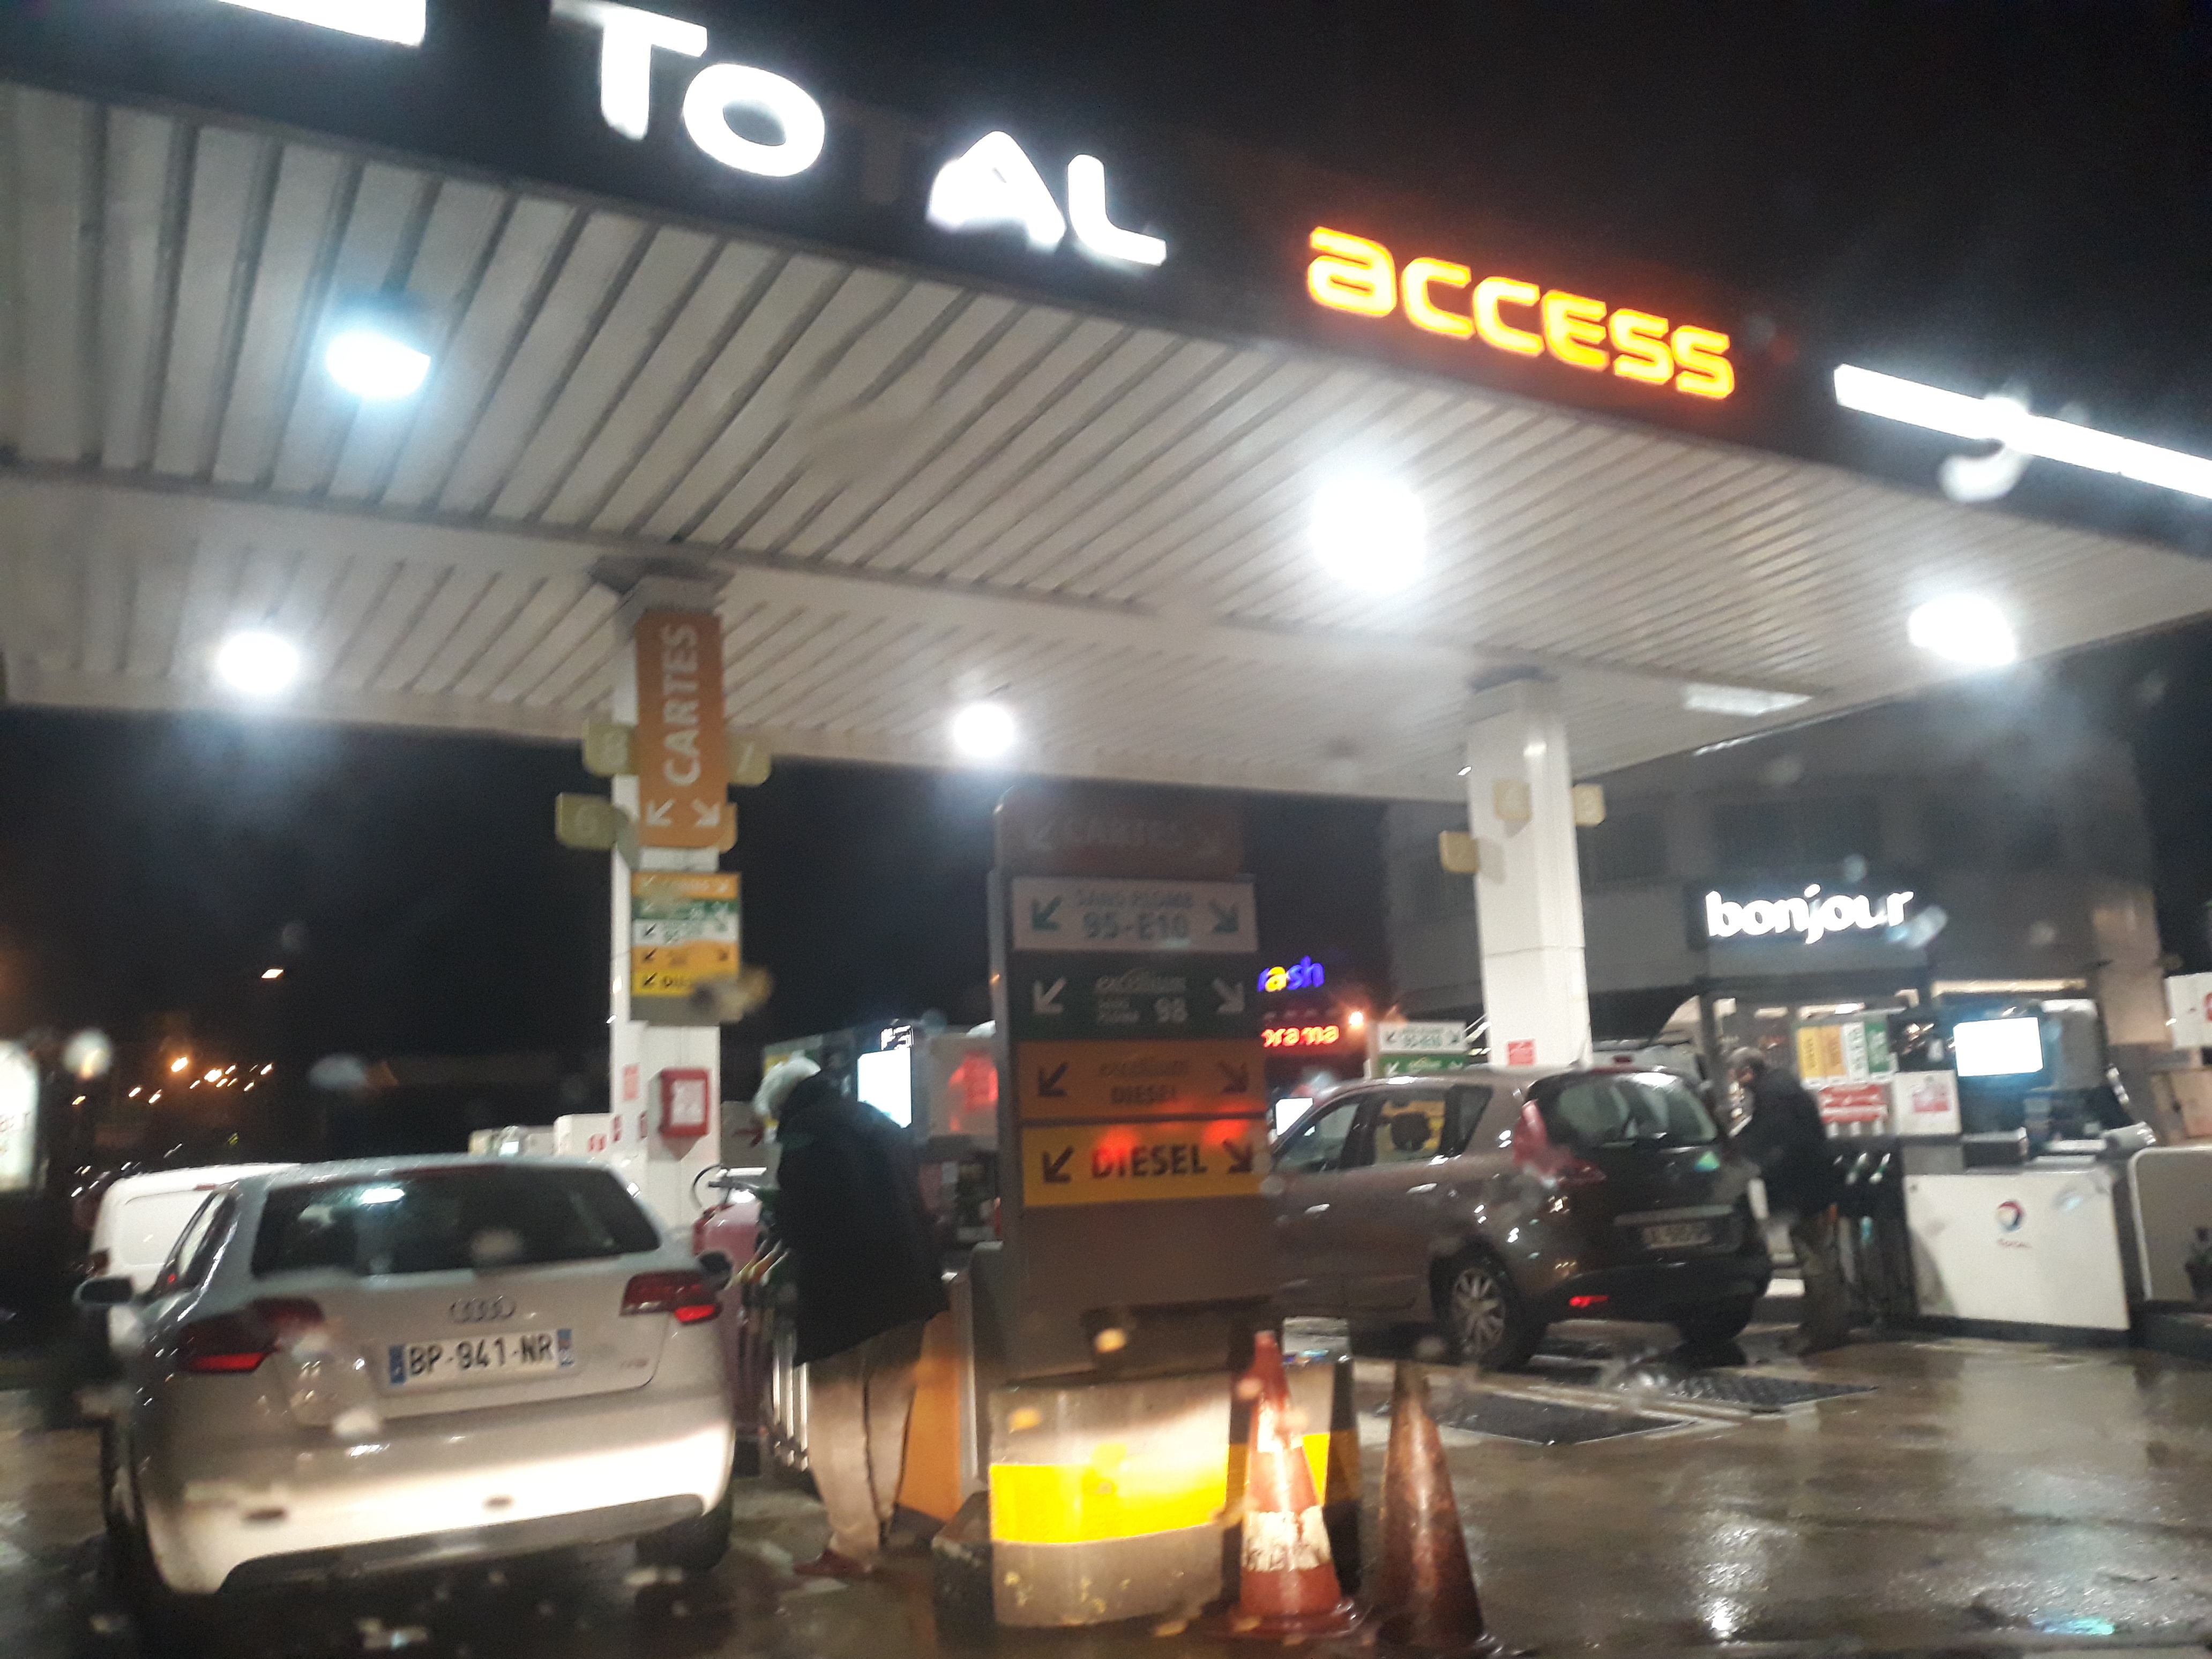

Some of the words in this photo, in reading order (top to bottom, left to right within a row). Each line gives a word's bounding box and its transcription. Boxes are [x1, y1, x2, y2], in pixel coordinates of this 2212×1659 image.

[662, 623, 701, 786] CARTES
[1083, 911, 1190, 940] 95-E10
[1706, 884, 1914, 944] bonjour
[1091, 1145, 1208, 1178] DIESEL
